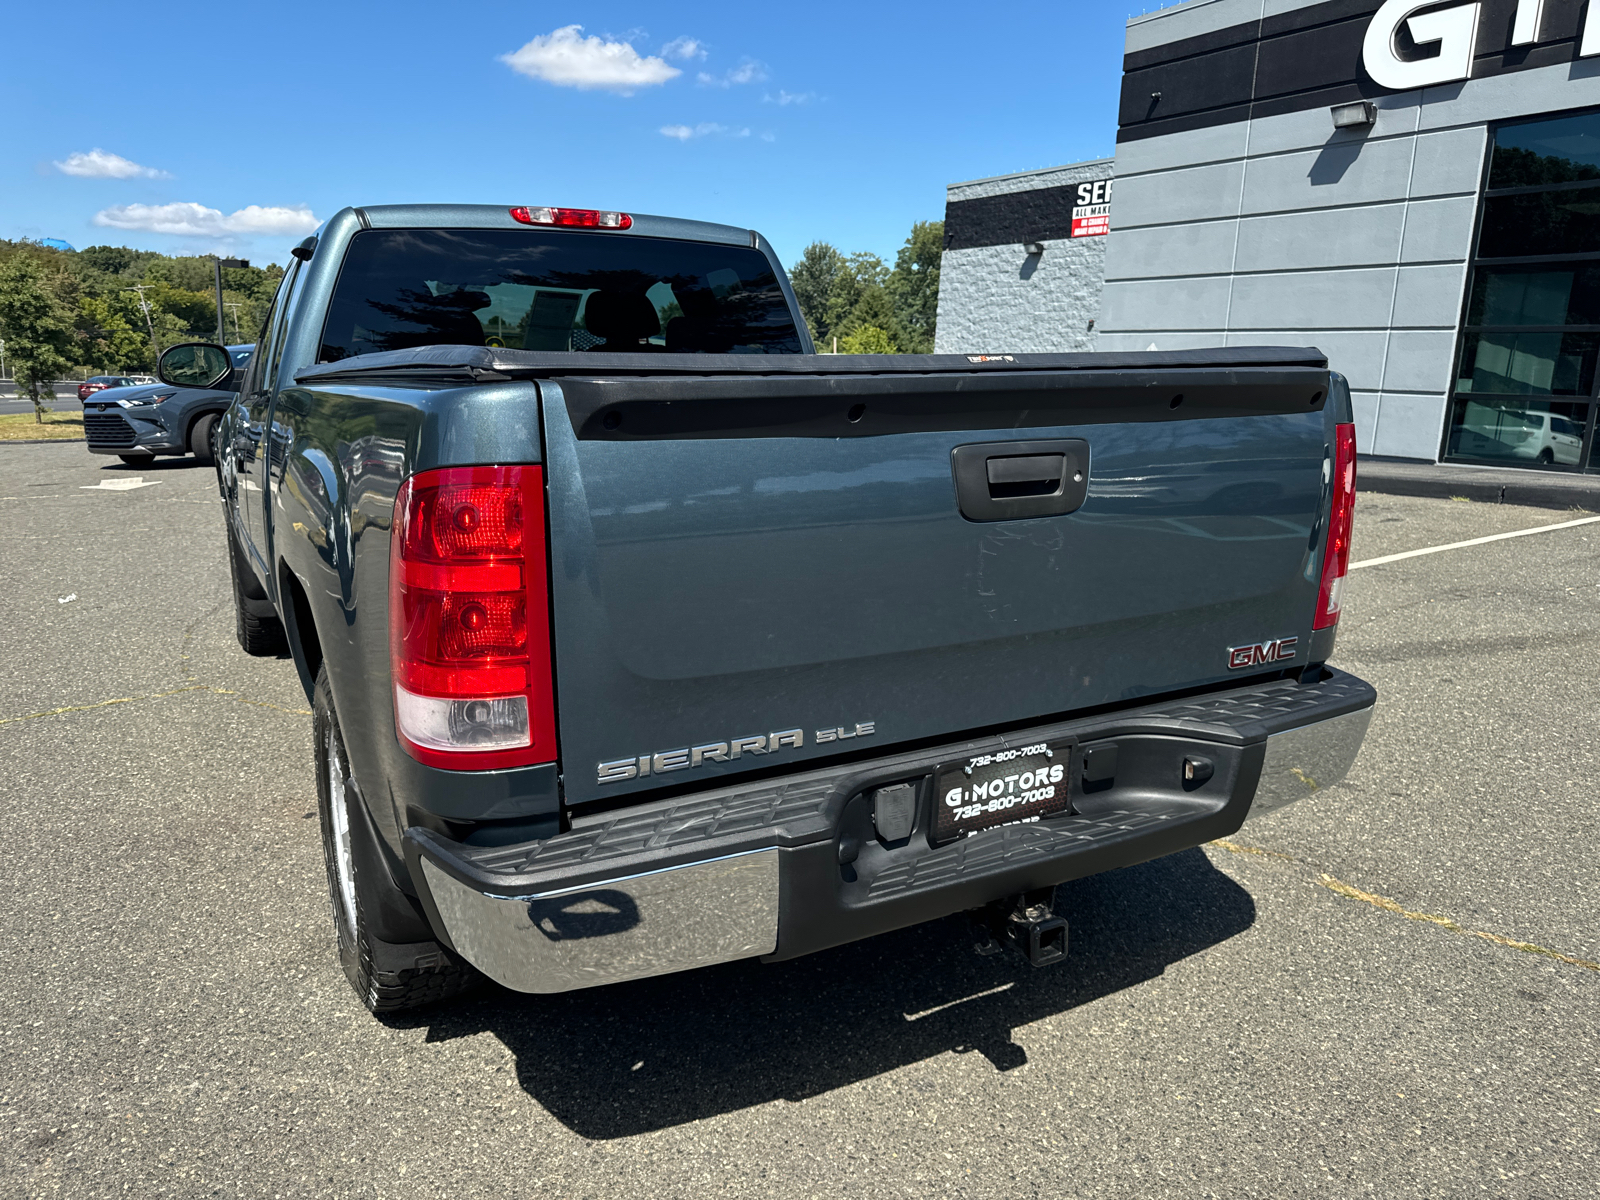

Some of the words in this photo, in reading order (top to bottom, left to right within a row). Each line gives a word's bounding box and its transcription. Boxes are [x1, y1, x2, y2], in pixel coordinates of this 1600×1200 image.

[1075, 207, 1087, 217] ALL
[1228, 636, 1298, 669] GMC
[597, 728, 804, 785] SIERRA
[815, 721, 876, 744] SLE
[969, 743, 1048, 768] 732-800-7003
[952, 785, 1056, 821] 732-800-7003
